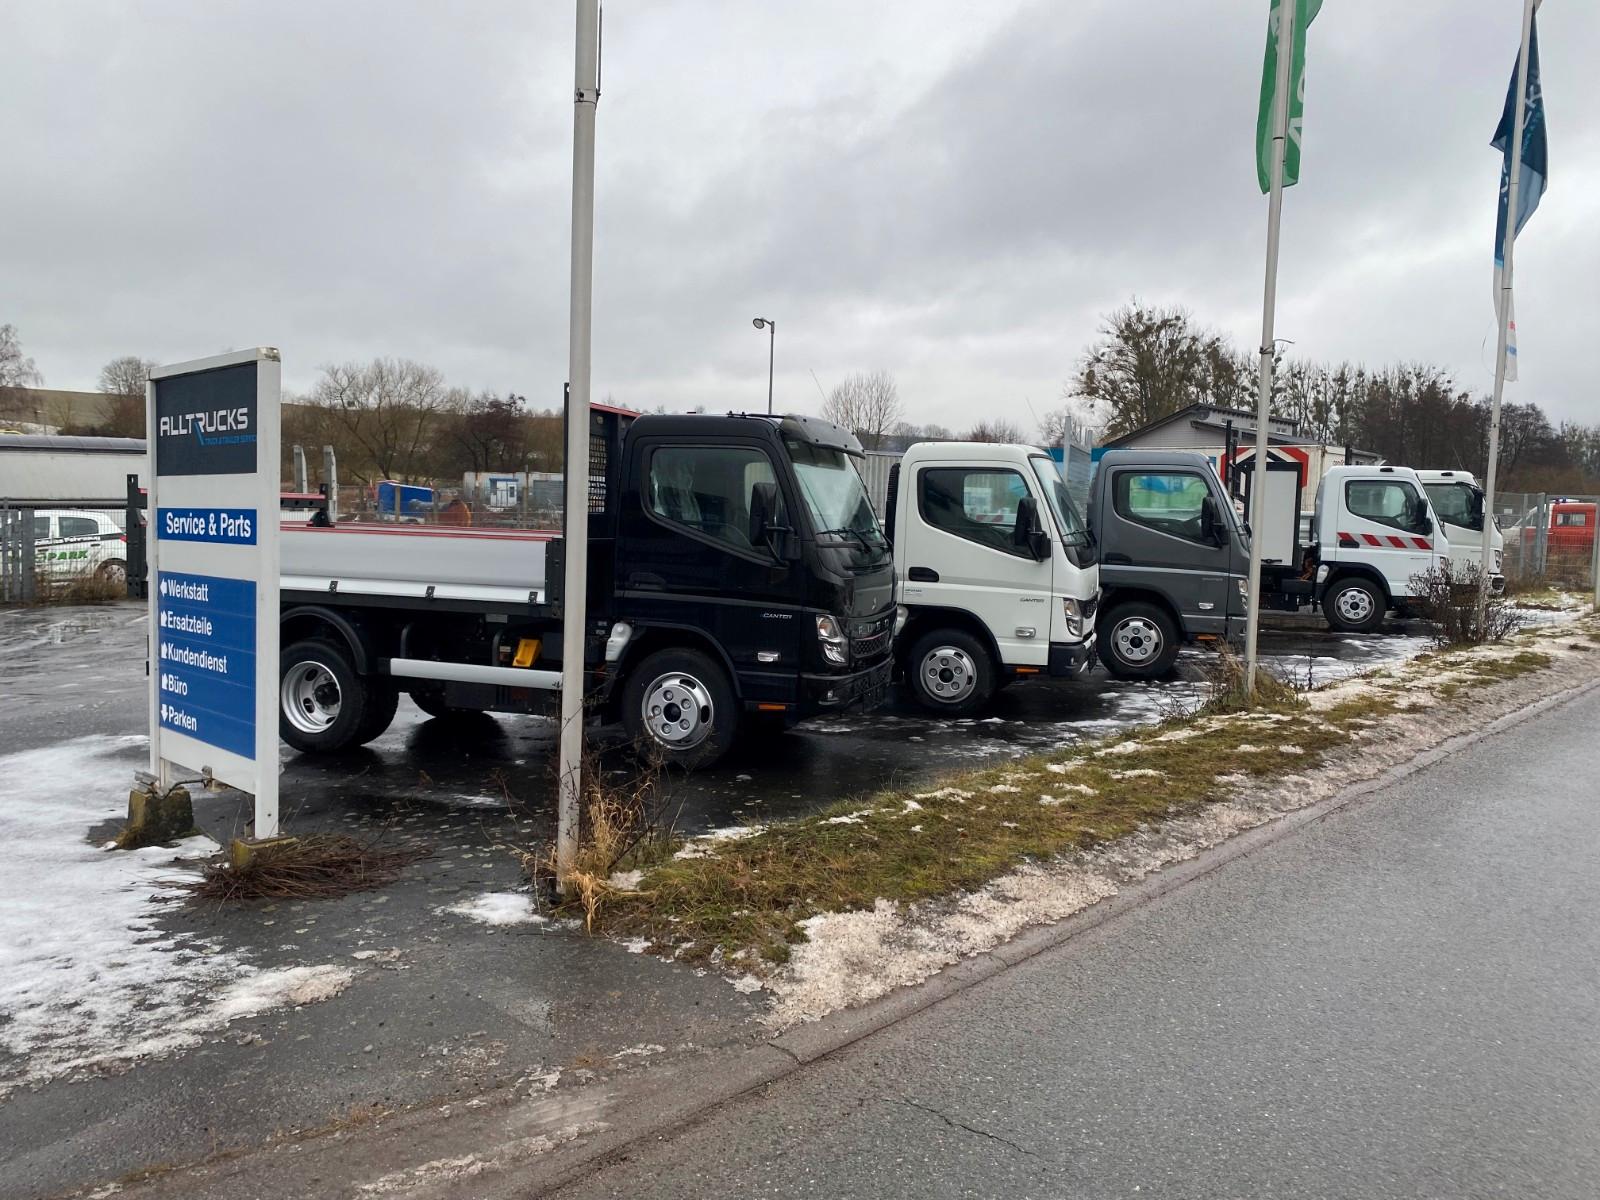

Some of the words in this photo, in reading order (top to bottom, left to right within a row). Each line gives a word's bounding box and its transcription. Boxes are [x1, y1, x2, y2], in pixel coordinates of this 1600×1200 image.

[160, 407, 249, 437] ALLTRUCKS
[166, 512, 206, 535] Service
[208, 513, 217, 535] &
[220, 513, 251, 537] Parts
[168, 579, 209, 602] Werkstatt
[168, 610, 213, 636] Ersatzteile
[168, 642, 228, 674] Kundendienst
[168, 674, 188, 696] Büro
[168, 705, 198, 731] Parken
